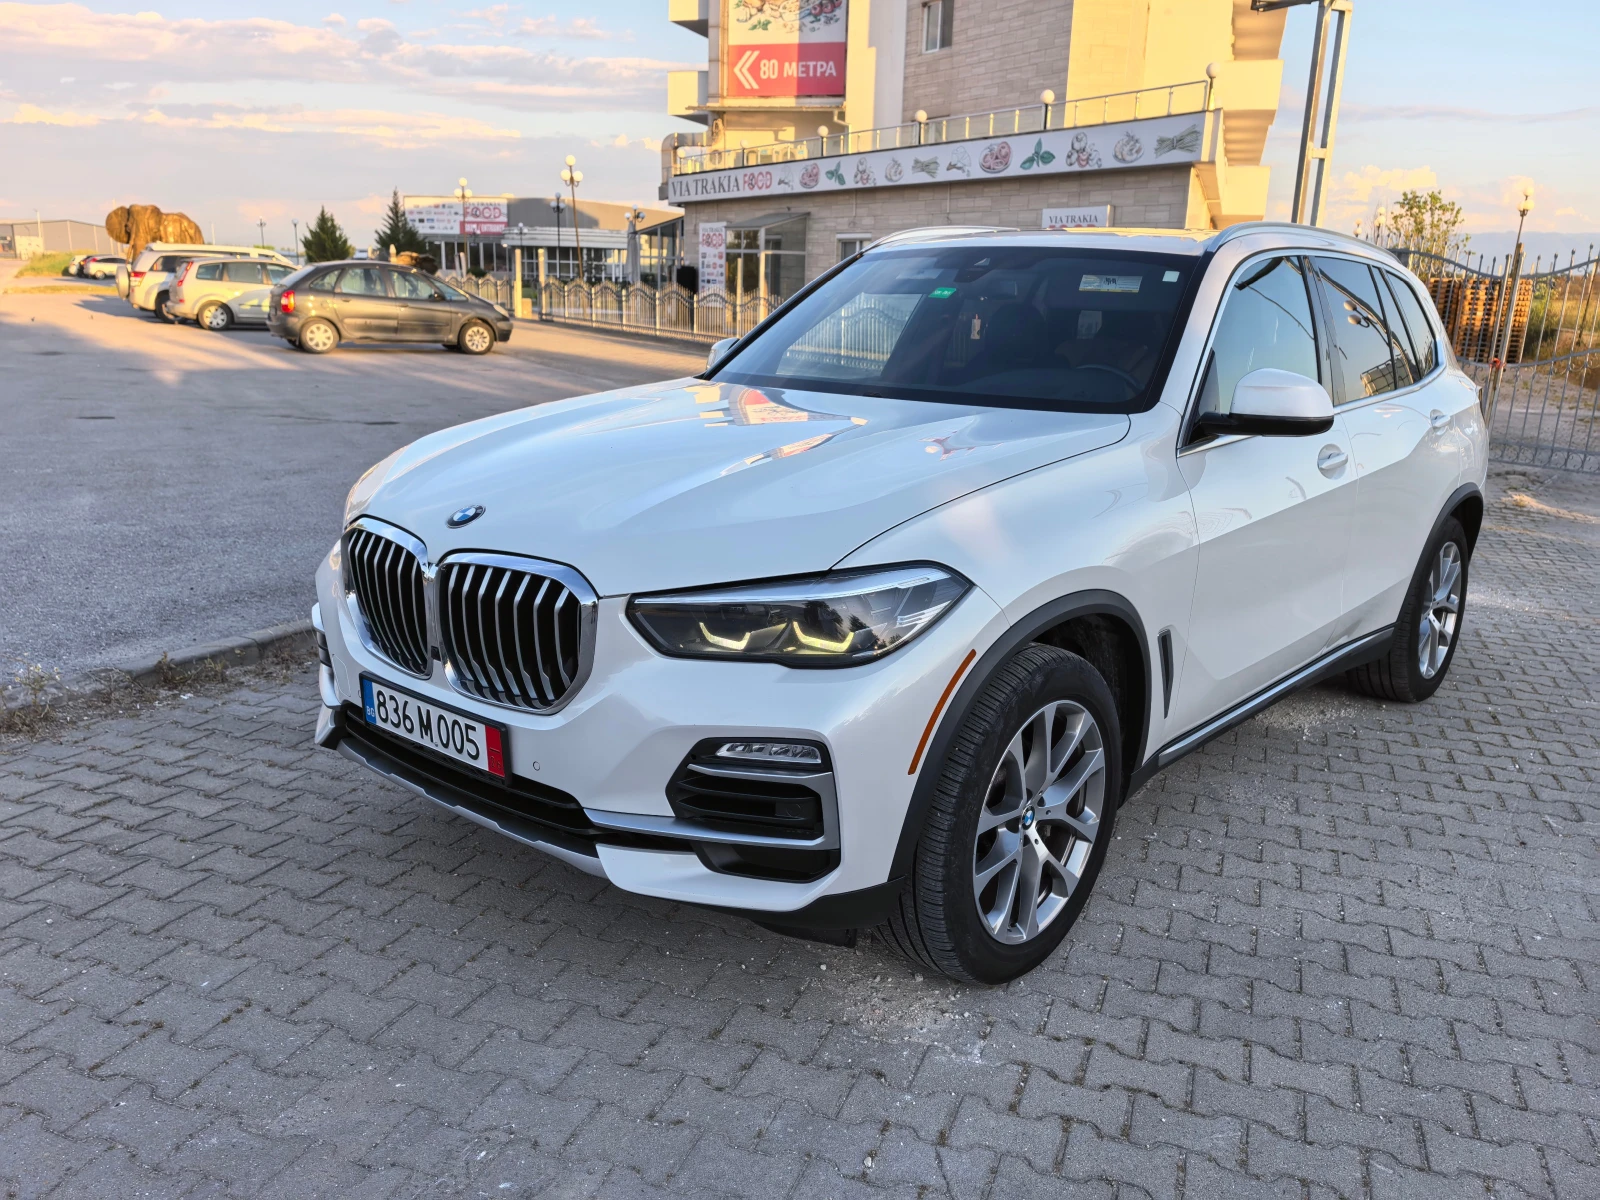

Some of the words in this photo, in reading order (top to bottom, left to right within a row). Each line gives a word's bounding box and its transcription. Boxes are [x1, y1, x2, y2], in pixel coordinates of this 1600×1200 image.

[760, 59, 779, 79] 80
[783, 61, 837, 78] МЕТРА
[671, 181, 691, 197] VIA
[693, 175, 741, 195] TRAKIA
[1049, 215, 1064, 224] VIA
[1065, 214, 1098, 224] TRAKIA
[366, 705, 375, 718] BG
[376, 689, 415, 734] 836
[437, 714, 480, 760] 005
